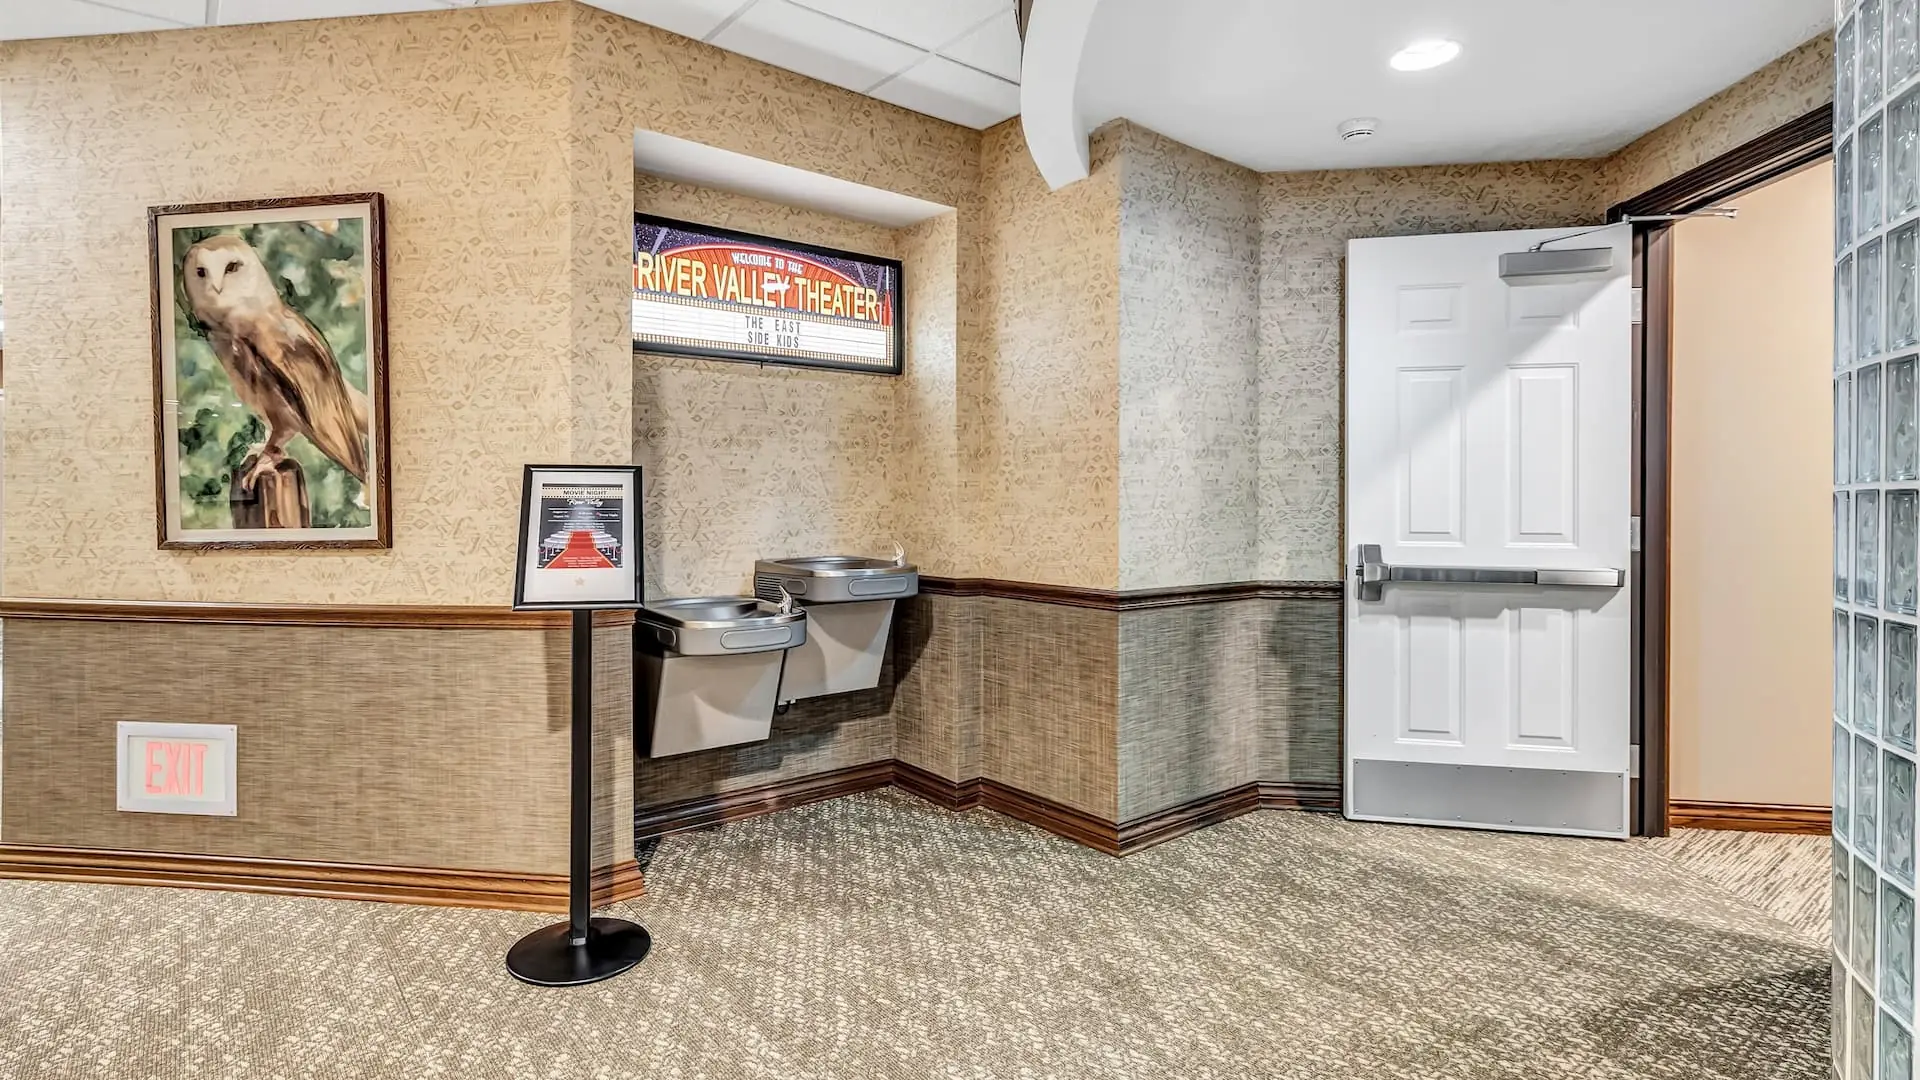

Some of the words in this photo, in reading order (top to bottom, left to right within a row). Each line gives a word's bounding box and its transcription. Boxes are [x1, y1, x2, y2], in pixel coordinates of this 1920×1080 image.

[731, 252, 772, 268] WELCOME
[774, 257, 785, 270] TO
[787, 260, 804, 275] THE
[637, 251, 708, 299] RIVER
[712, 263, 790, 309] VALLEY
[794, 276, 879, 322] THEATER
[745, 315, 764, 330] THE
[775, 319, 801, 336] EAST
[747, 331, 769, 346] SIDE
[776, 333, 799, 349] KIDS
[145, 741, 208, 797] EXIT
